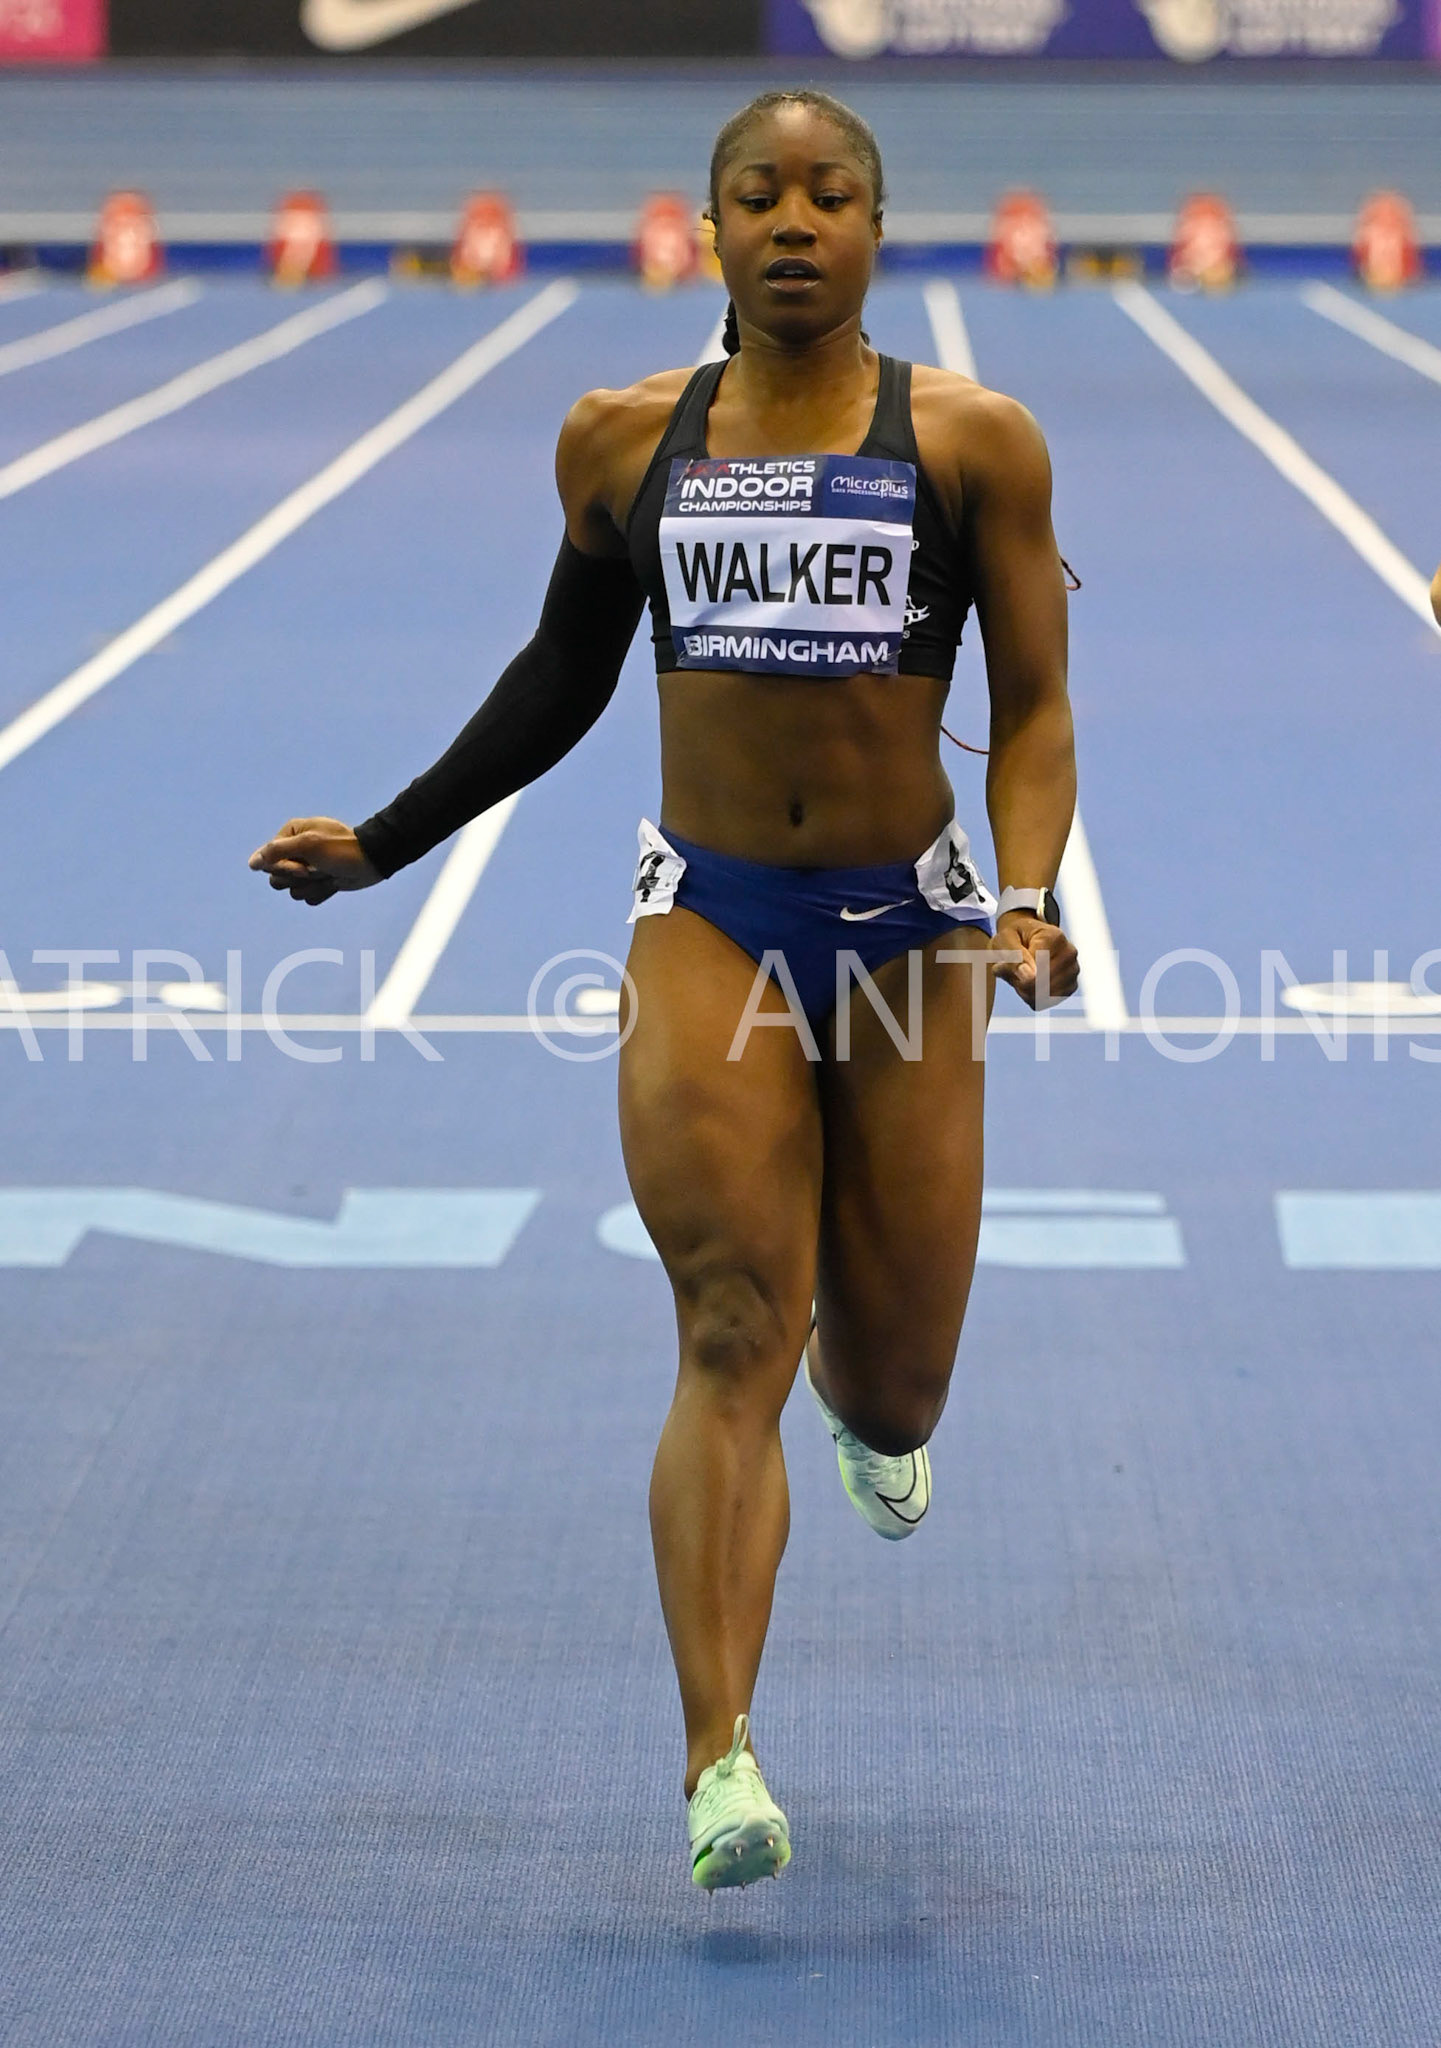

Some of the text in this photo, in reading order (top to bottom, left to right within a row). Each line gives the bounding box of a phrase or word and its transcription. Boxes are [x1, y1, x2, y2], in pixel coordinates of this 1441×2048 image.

[681, 476, 814, 499] INDOOR
[831, 475, 908, 499] Microplus
[679, 500, 812, 513] CHAMPIONSHIPS
[676, 542, 893, 606] WALKER
[684, 634, 889, 664] BIRMINGHAM
